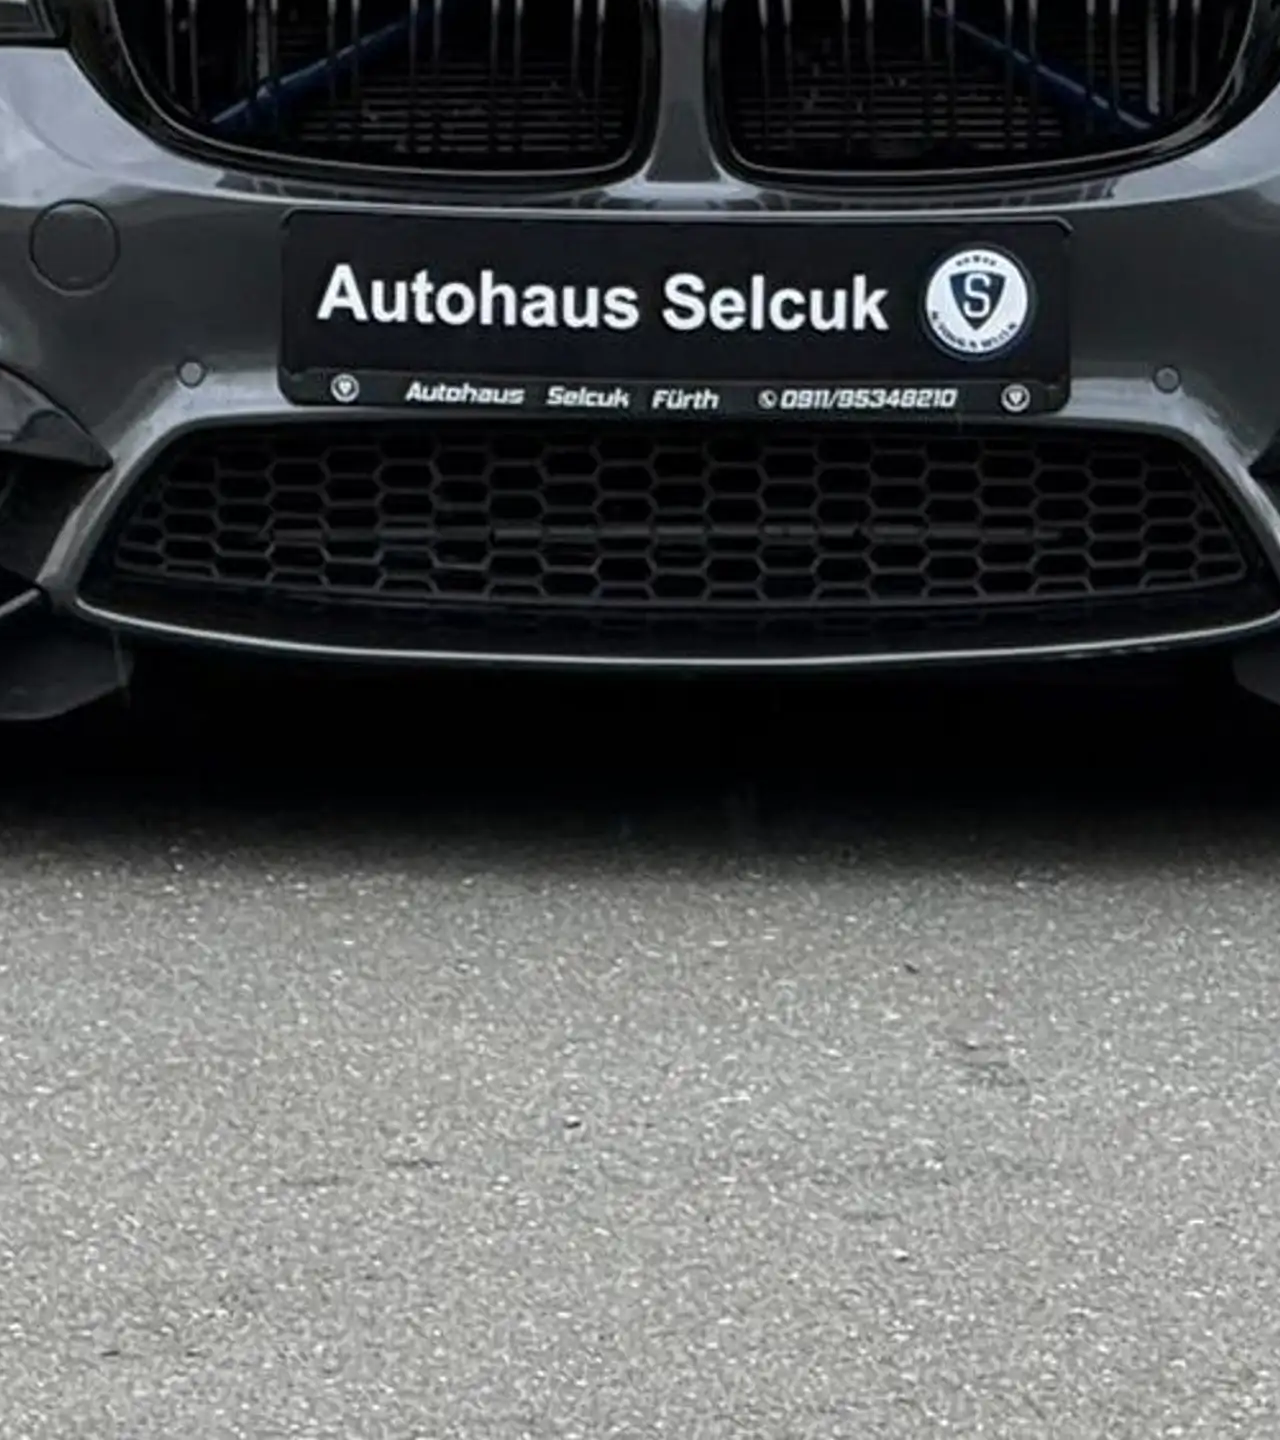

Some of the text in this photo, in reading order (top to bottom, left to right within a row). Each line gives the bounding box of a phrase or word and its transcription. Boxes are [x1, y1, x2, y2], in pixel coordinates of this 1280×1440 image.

[317, 263, 890, 331] Autohaus Selcuk
[405, 380, 525, 405] Autohaus
[546, 385, 630, 409] Selcuk
[651, 388, 719, 410] Fürth
